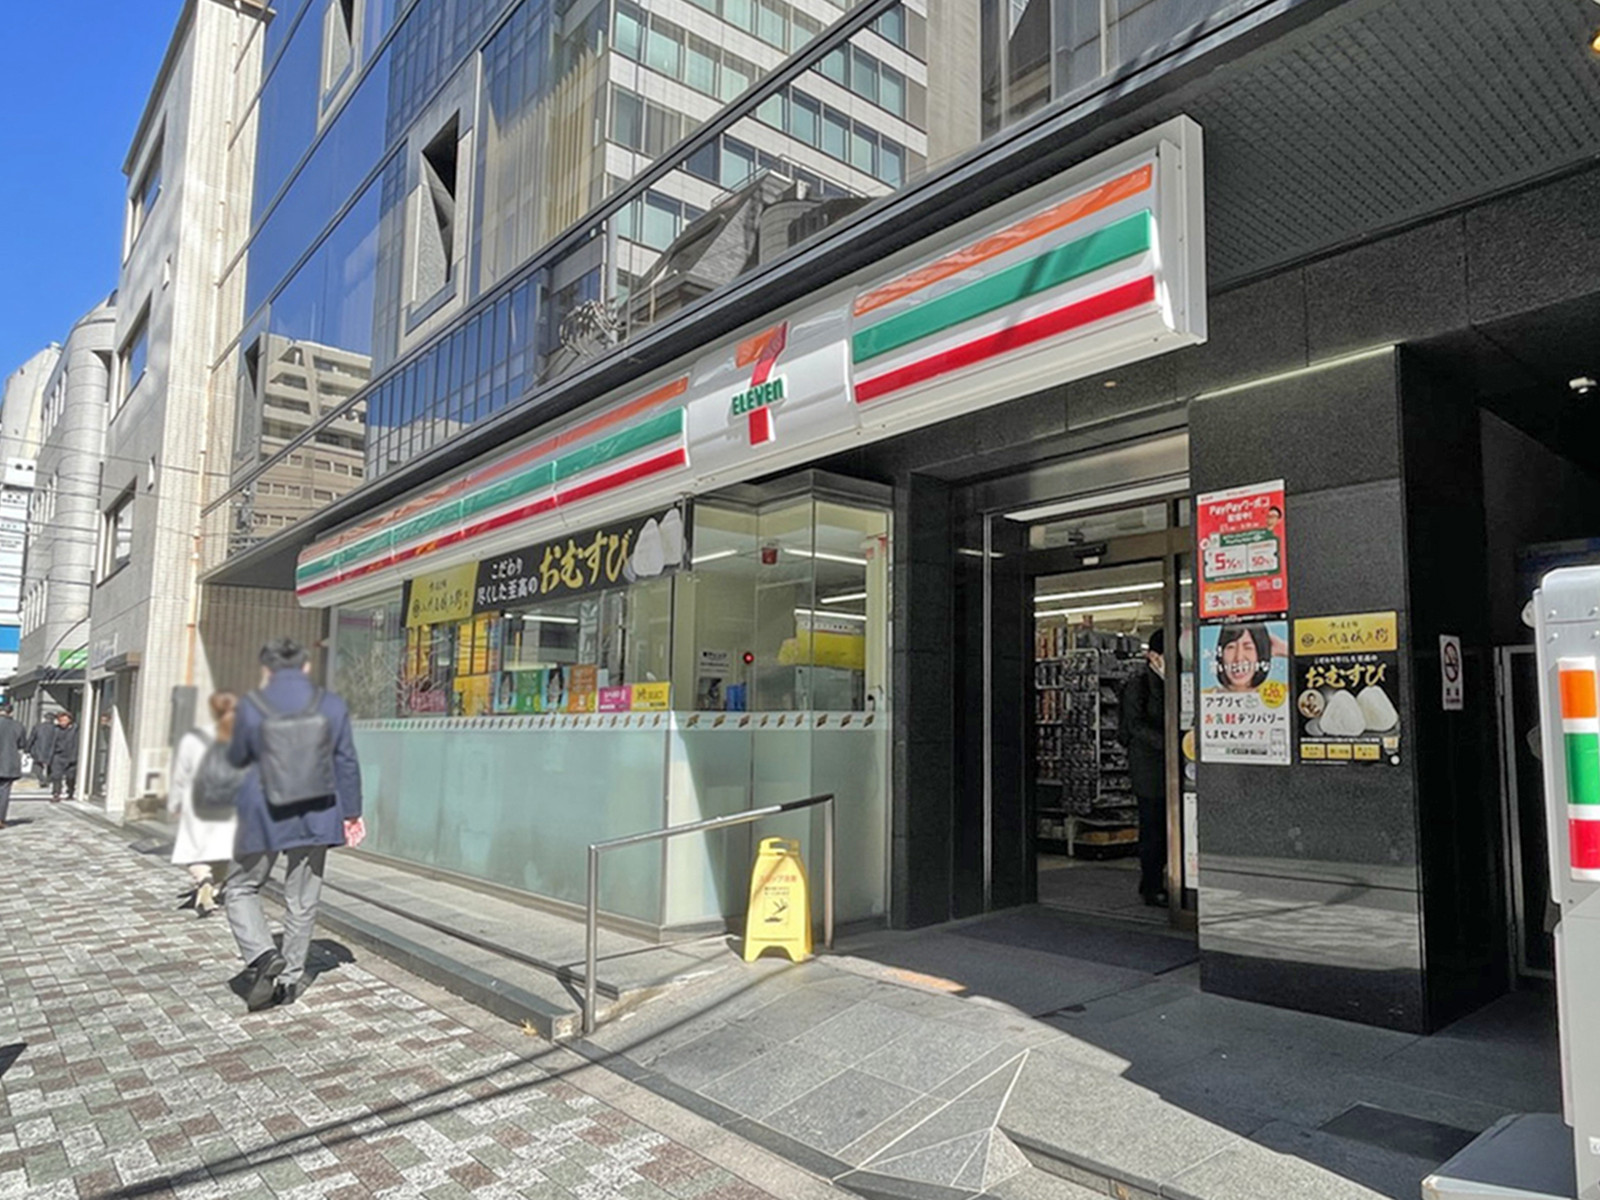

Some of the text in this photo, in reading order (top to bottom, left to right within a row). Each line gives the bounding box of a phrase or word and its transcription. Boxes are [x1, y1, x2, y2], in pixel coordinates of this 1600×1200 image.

[734, 320, 788, 446] 7
[491, 557, 523, 579] こだわり
[539, 528, 633, 594] おむすび
[1205, 696, 1243, 708] アプリで
[1204, 713, 1285, 725] お気軽デリバリー
